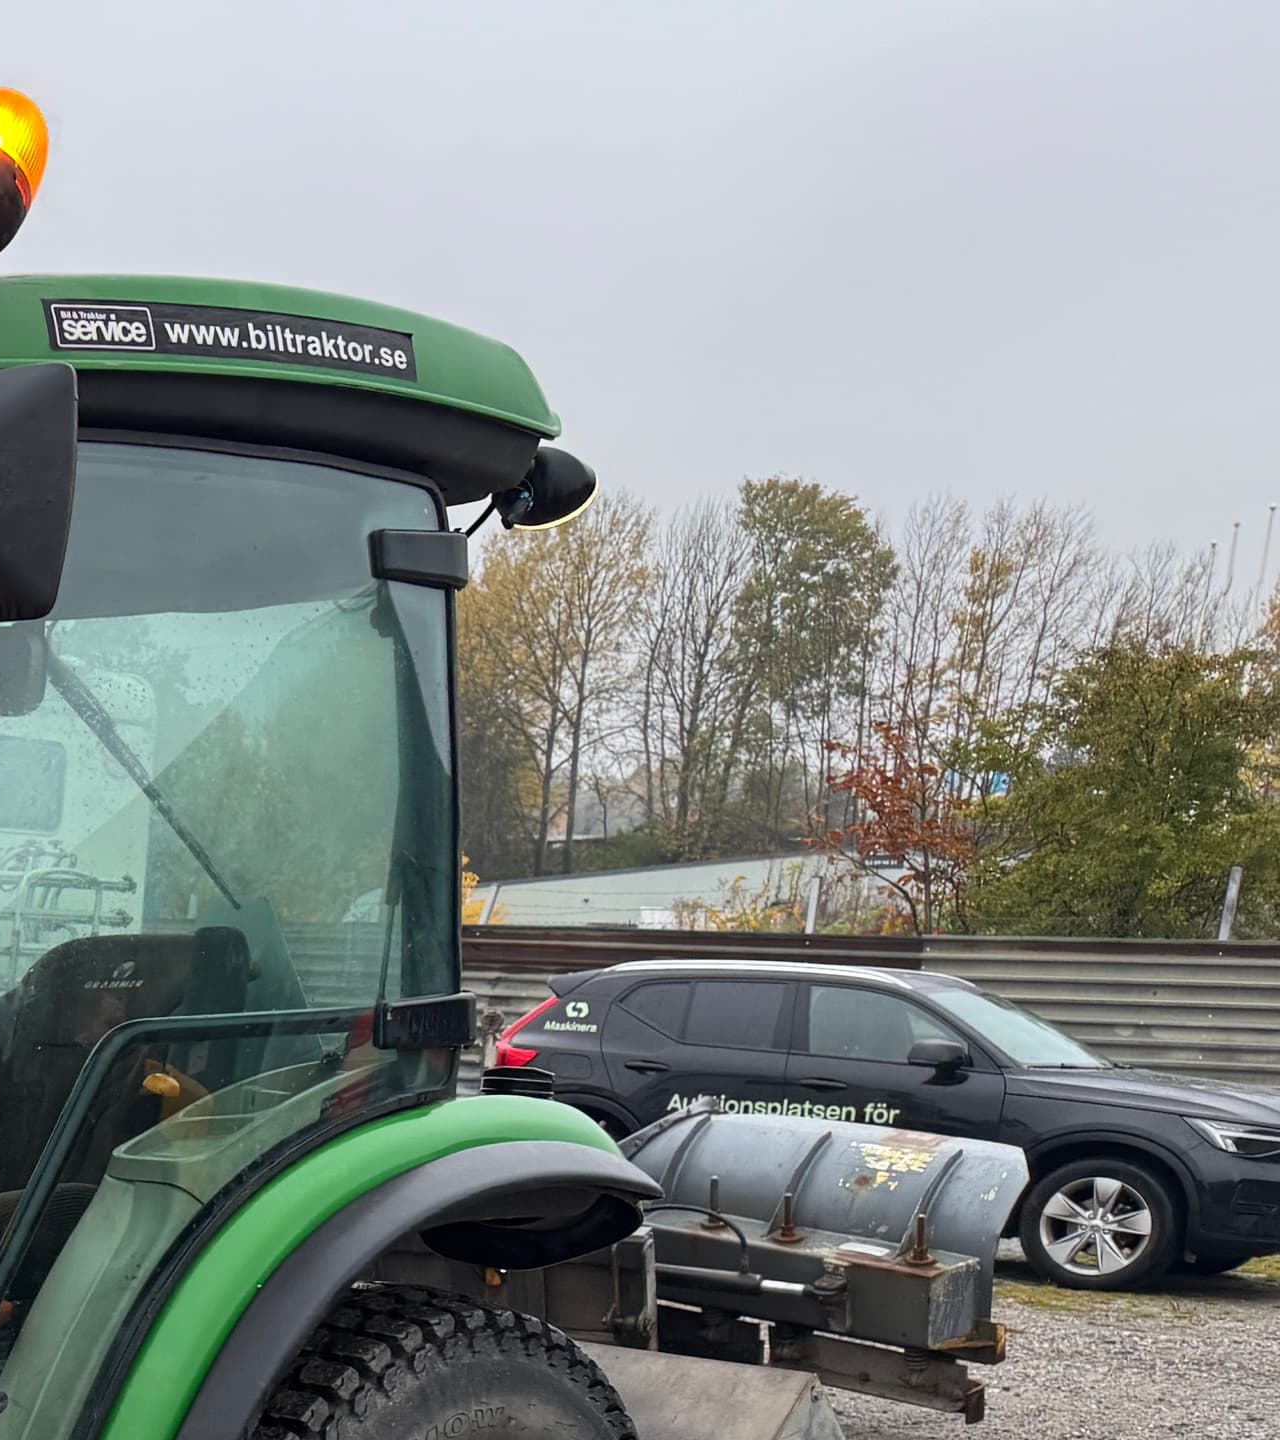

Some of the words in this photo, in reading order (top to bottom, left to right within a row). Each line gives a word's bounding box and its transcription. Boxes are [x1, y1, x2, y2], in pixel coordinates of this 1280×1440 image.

[62, 314, 147, 343] service
[164, 320, 408, 370] www.biltraktor.se
[544, 1020, 597, 1033] Maskinera
[667, 1094, 855, 1121] Auionsplatsen
[864, 1102, 900, 1124] för
